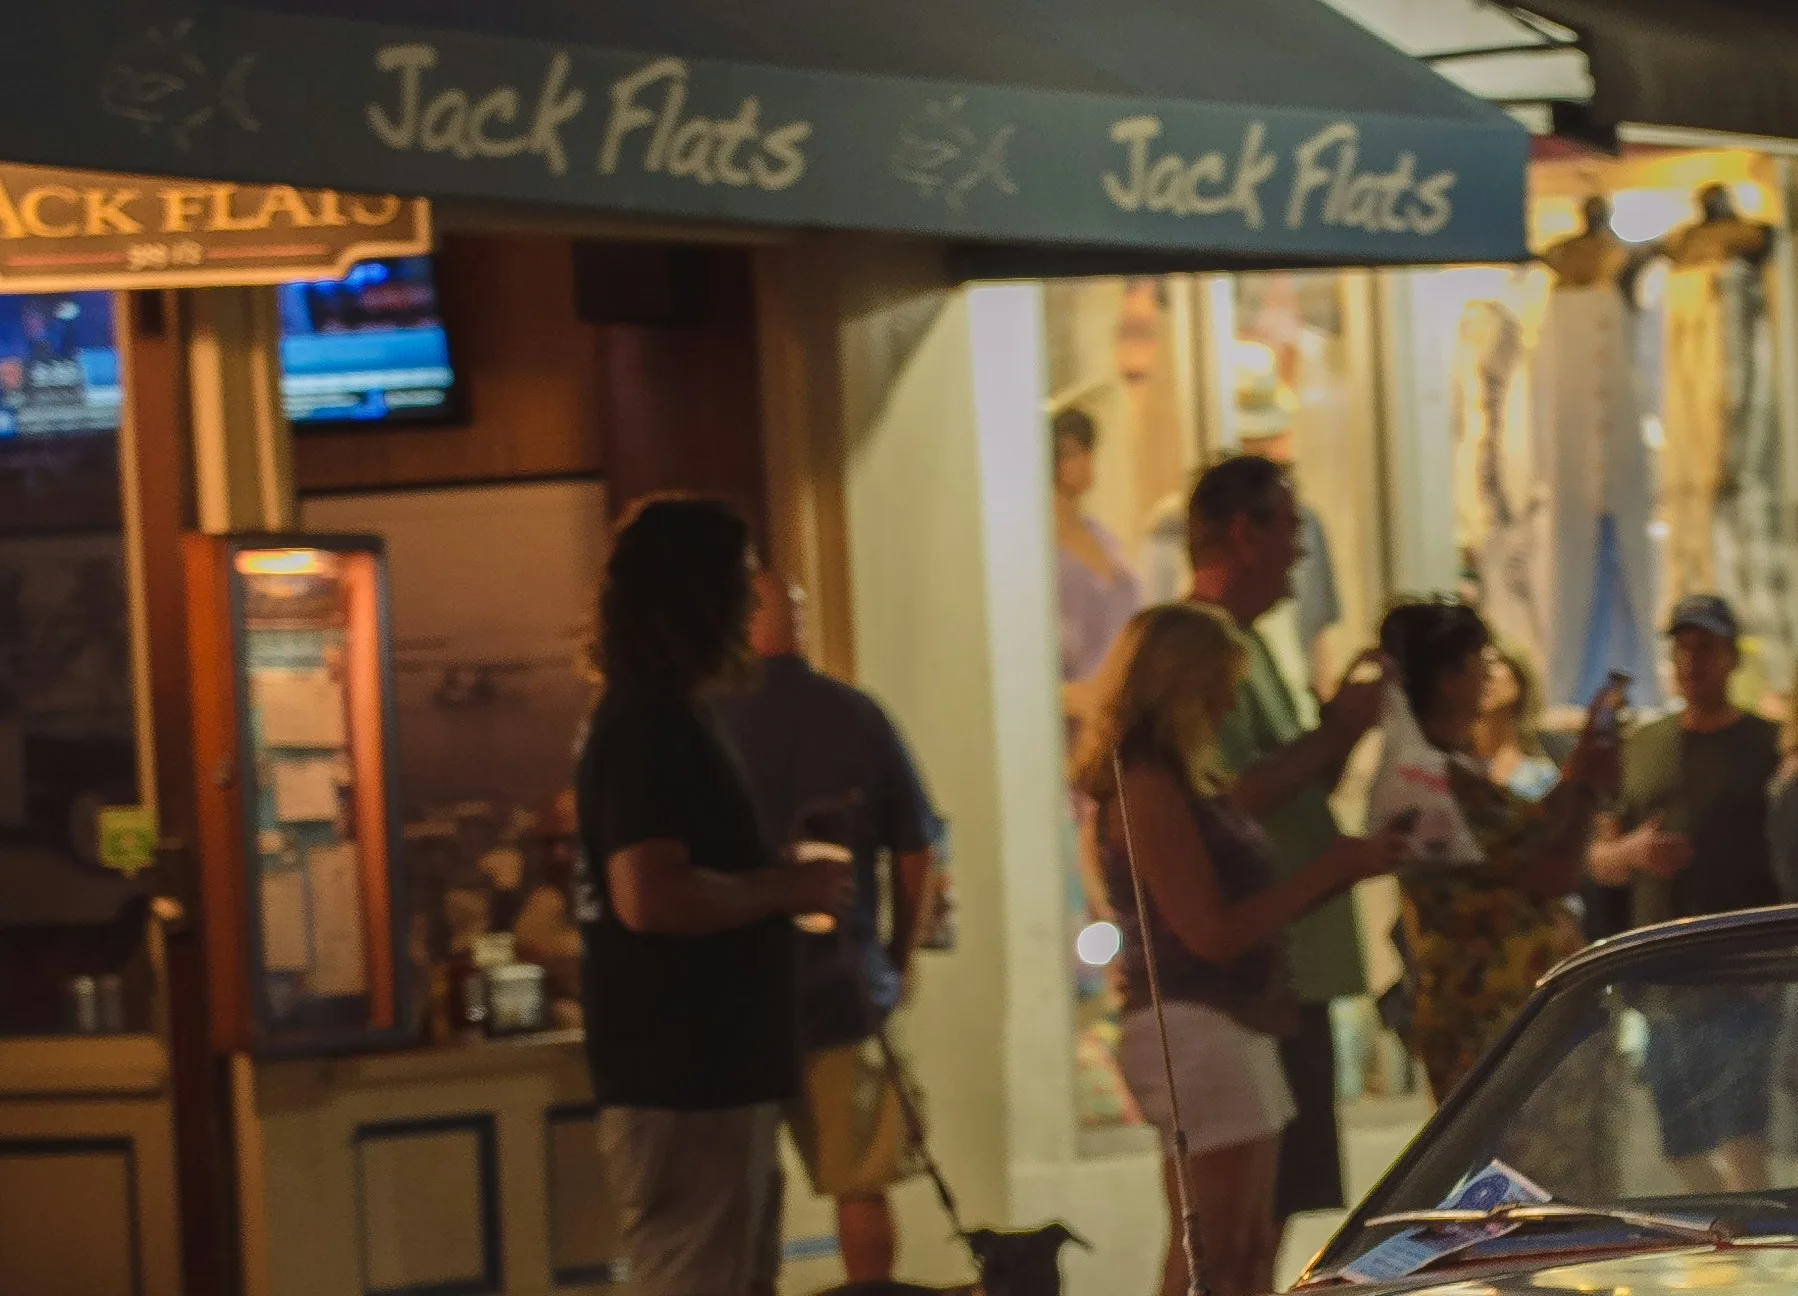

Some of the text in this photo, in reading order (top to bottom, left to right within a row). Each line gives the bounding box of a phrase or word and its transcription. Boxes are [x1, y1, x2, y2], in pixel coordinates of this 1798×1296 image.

[368, 45, 811, 189] Jack Flats
[1103, 116, 1457, 233] Jack Flats
